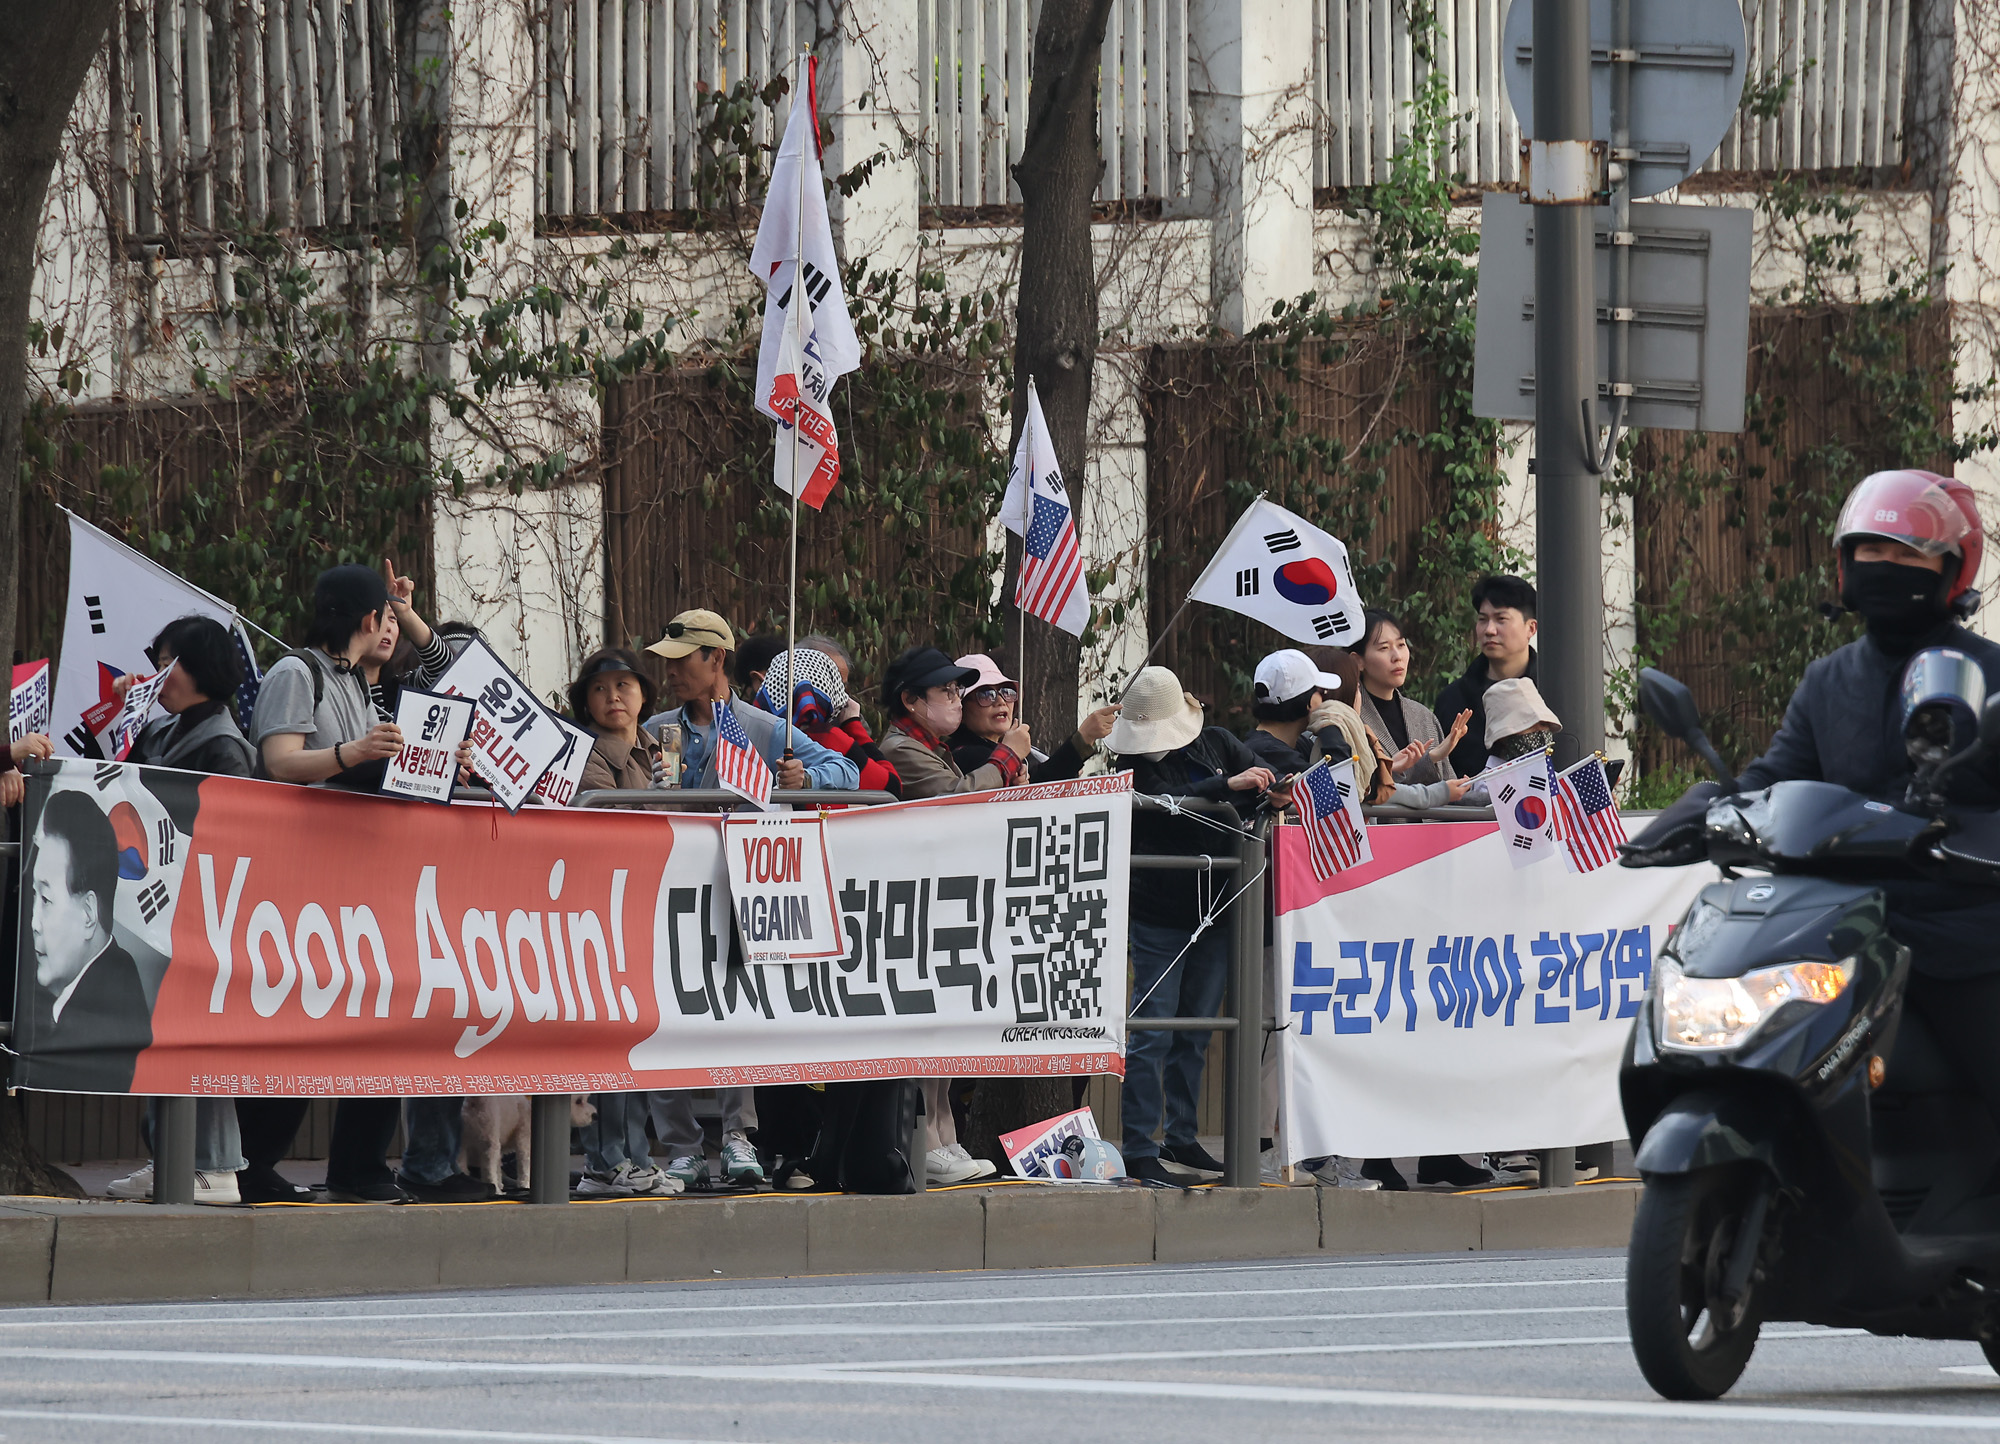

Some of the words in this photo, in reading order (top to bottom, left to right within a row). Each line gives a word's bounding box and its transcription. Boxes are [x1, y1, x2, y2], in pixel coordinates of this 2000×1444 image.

[798, 406, 828, 437] THE
[1874, 510, 1898, 523] 88
[478, 677, 538, 742] 윤카
[393, 744, 449, 779] 사랑합니다.
[742, 836, 803, 883] YOON
[740, 895, 813, 941] AGAIN
[198, 853, 393, 1018] Yoon
[411, 858, 638, 1058] Again!
[753, 952, 769, 961] RESET
[769, 952, 788, 961] KOREA
[1290, 938, 1415, 1035] 누군가
[1427, 934, 1525, 1028] 해야
[1531, 925, 1652, 1023] 한다면
[835, 1059, 907, 1076] 010-5678-2017
[942, 1057, 1006, 1072] 010-8021-0322
[1818, 1054, 1839, 1079] DNA
[1835, 1016, 1870, 1060] MOTORS
[190, 1075, 200, 1093] 본
[202, 1074, 239, 1094] 현수막을
[265, 1074, 283, 1094] 철거
[285, 1075, 295, 1093] 시
[336, 1075, 355, 1093] 의해
[356, 1075, 393, 1093] 처벌되며
[393, 1075, 414, 1094] 협박
[414, 1075, 442, 1093] 문자는
[442, 1074, 466, 1093] 경찰,
[465, 1075, 495, 1093] 국정원
[494, 1074, 530, 1092] 자동신고
[530, 1074, 544, 1091] 및
[587, 1072, 638, 1089] 공지합니다.
